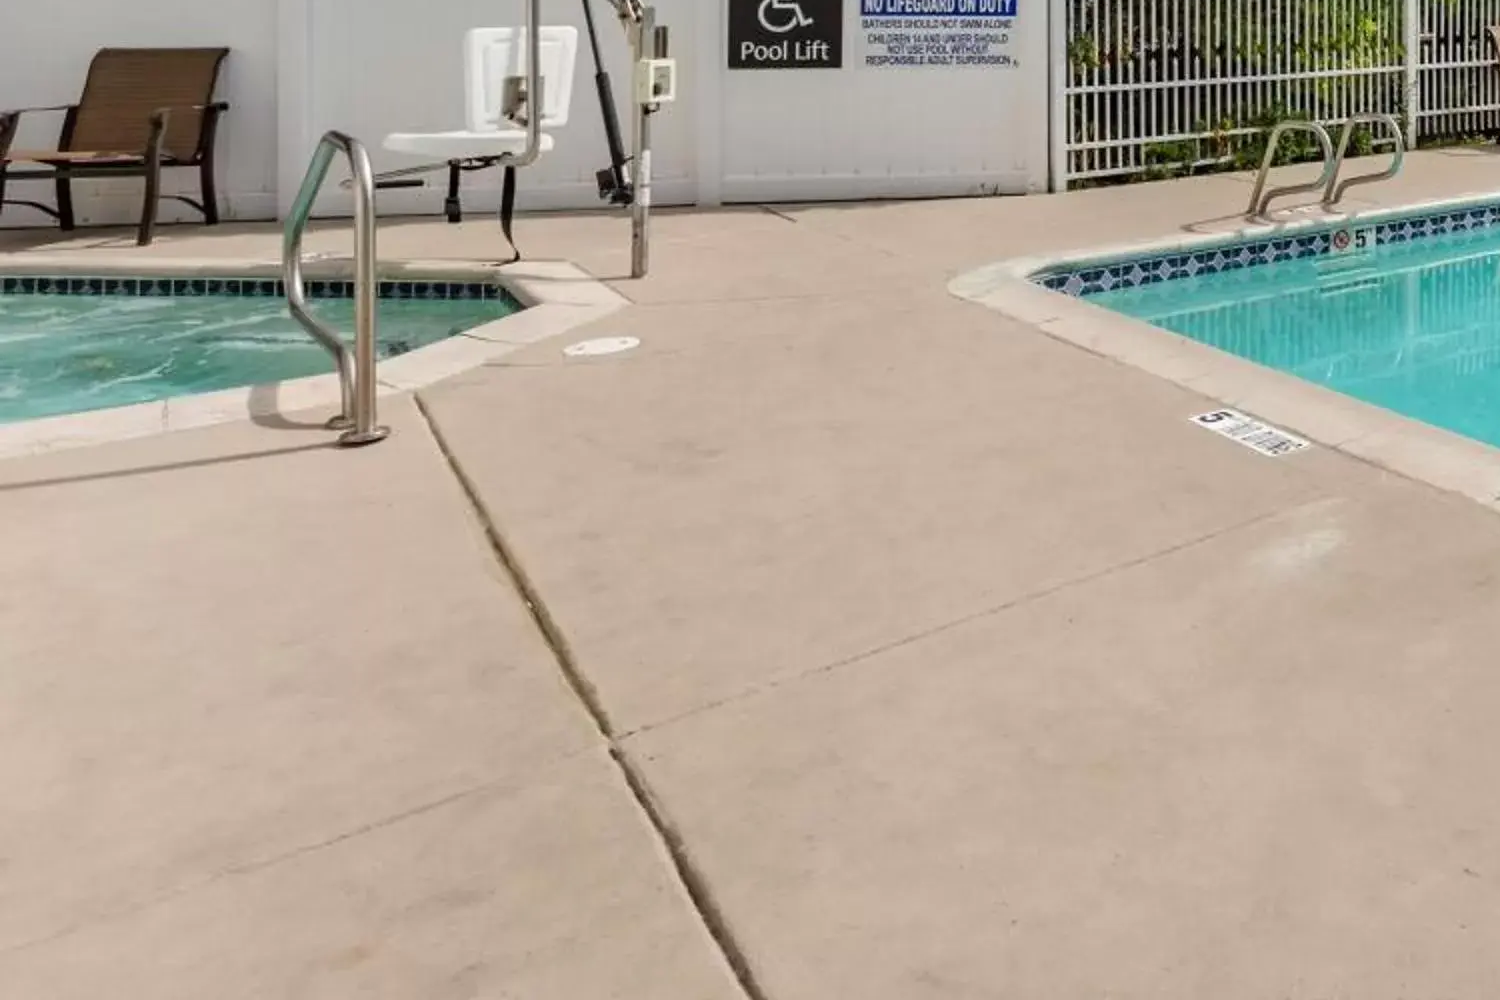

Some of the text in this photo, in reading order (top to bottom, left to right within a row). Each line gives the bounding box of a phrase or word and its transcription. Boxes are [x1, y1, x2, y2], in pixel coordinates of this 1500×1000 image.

[741, 40, 830, 61] Pool Lift
[1355, 229, 1367, 248] 5
